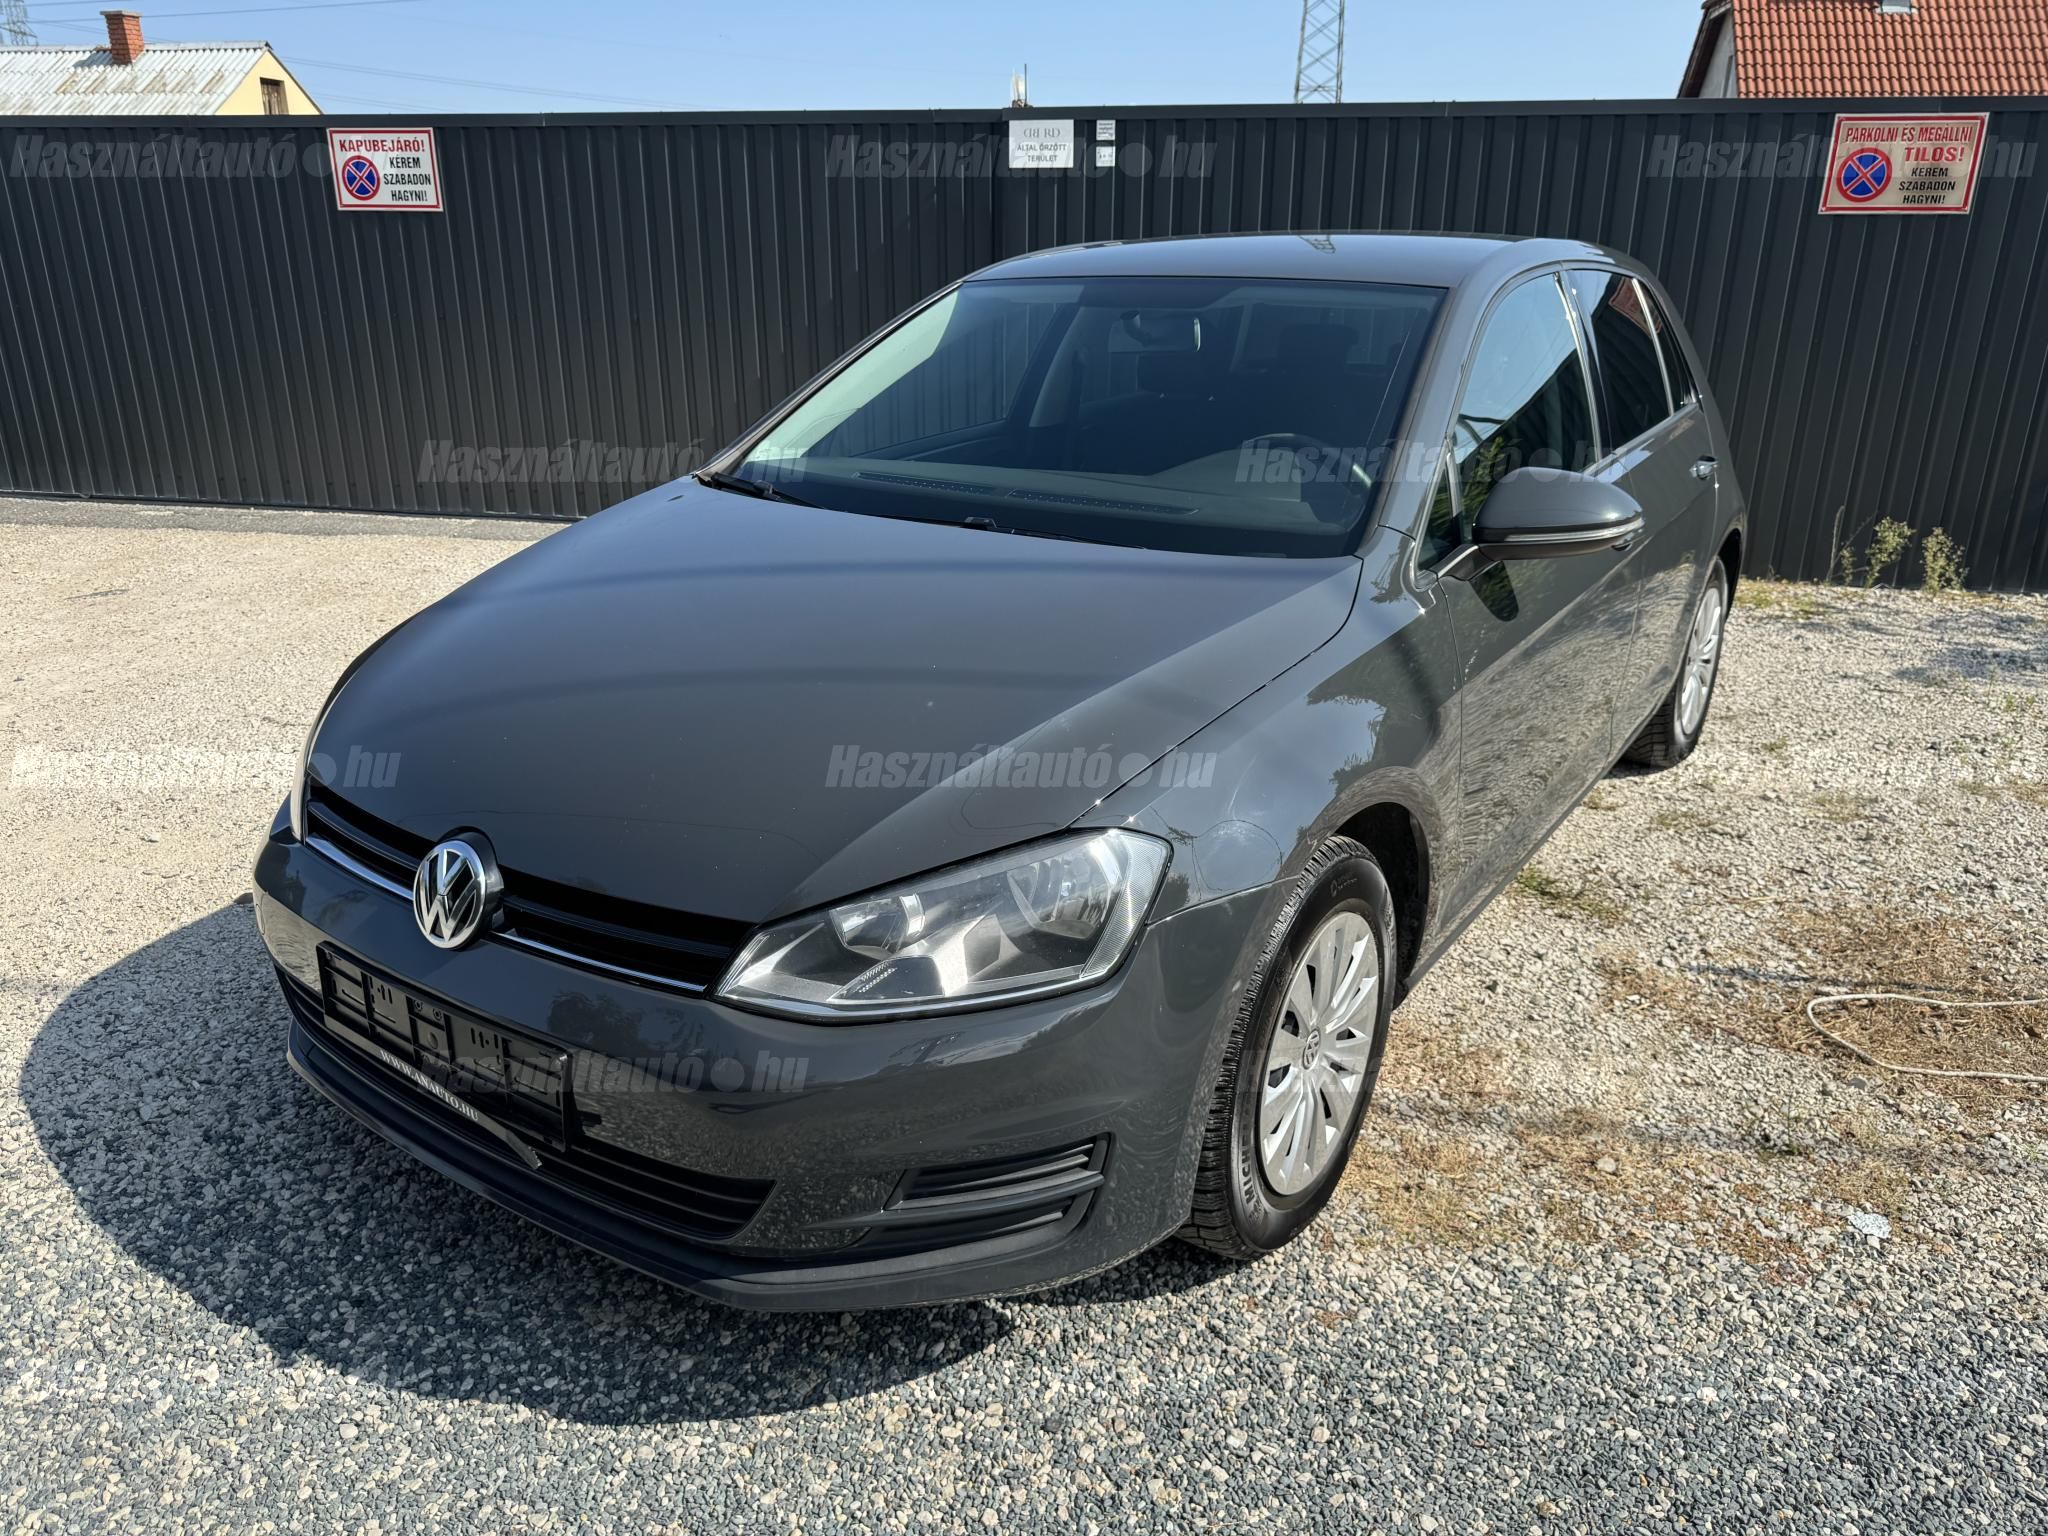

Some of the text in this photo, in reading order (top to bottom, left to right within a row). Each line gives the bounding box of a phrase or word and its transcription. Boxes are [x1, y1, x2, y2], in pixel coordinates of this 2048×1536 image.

[1845, 127, 1898, 142] PARKOLNI
[339, 137, 425, 152] KAPUBEJÁRÓ!
[1904, 146, 1965, 162] TILOS!
[389, 155, 421, 168] KÉREM
[383, 173, 432, 185] SZABADON
[1898, 181, 1956, 191] SZABADON
[391, 190, 428, 202] HAGYNI!
[1902, 194, 1946, 204] HAGYNI!
